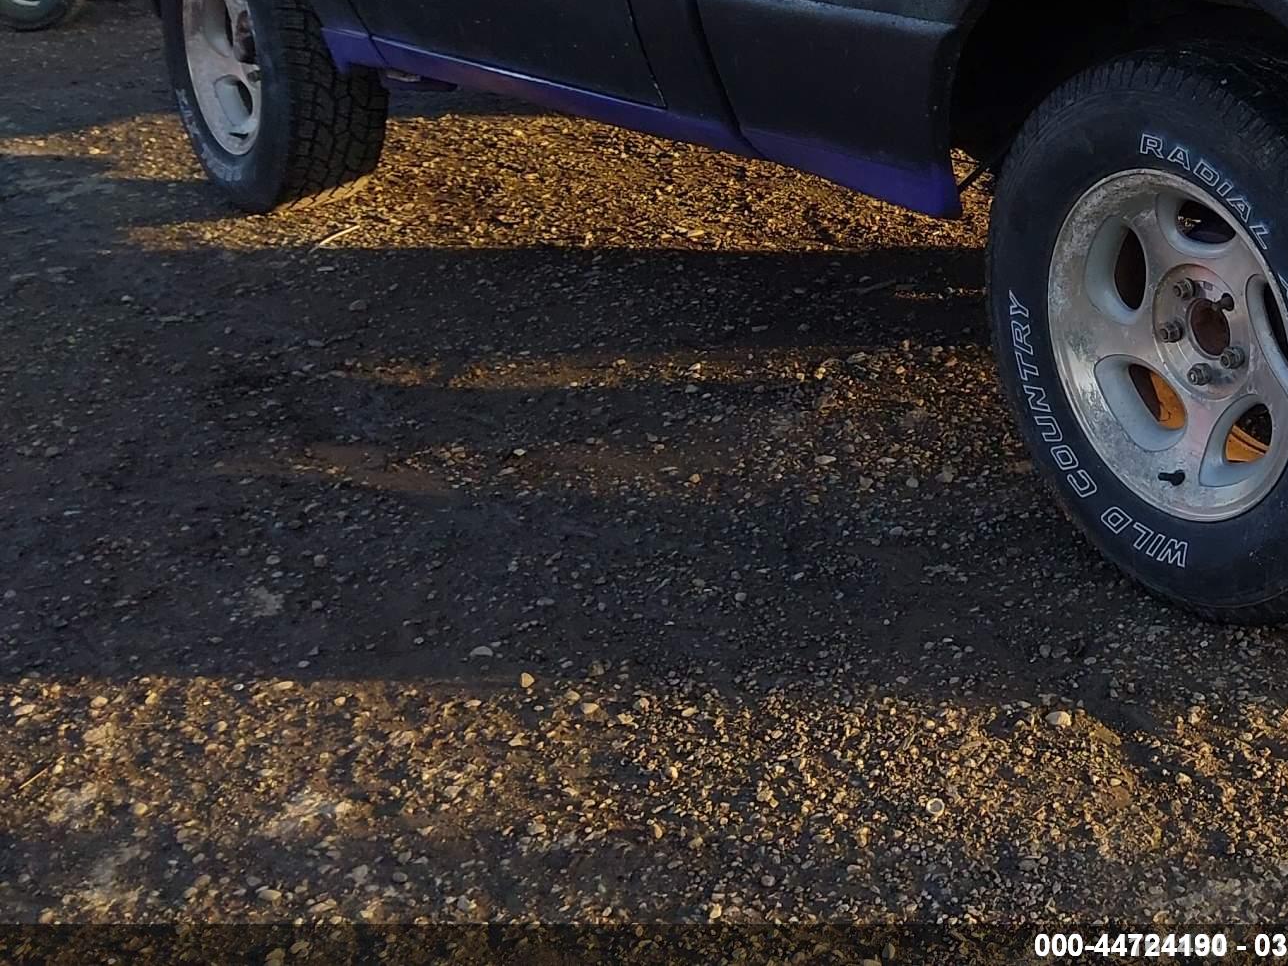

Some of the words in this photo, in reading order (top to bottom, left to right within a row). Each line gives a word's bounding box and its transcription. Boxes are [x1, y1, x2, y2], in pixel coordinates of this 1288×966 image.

[1139, 133, 1270, 251] RADIAL
[1008, 290, 1098, 498] COUNTRY
[1100, 506, 1189, 568] WILD
